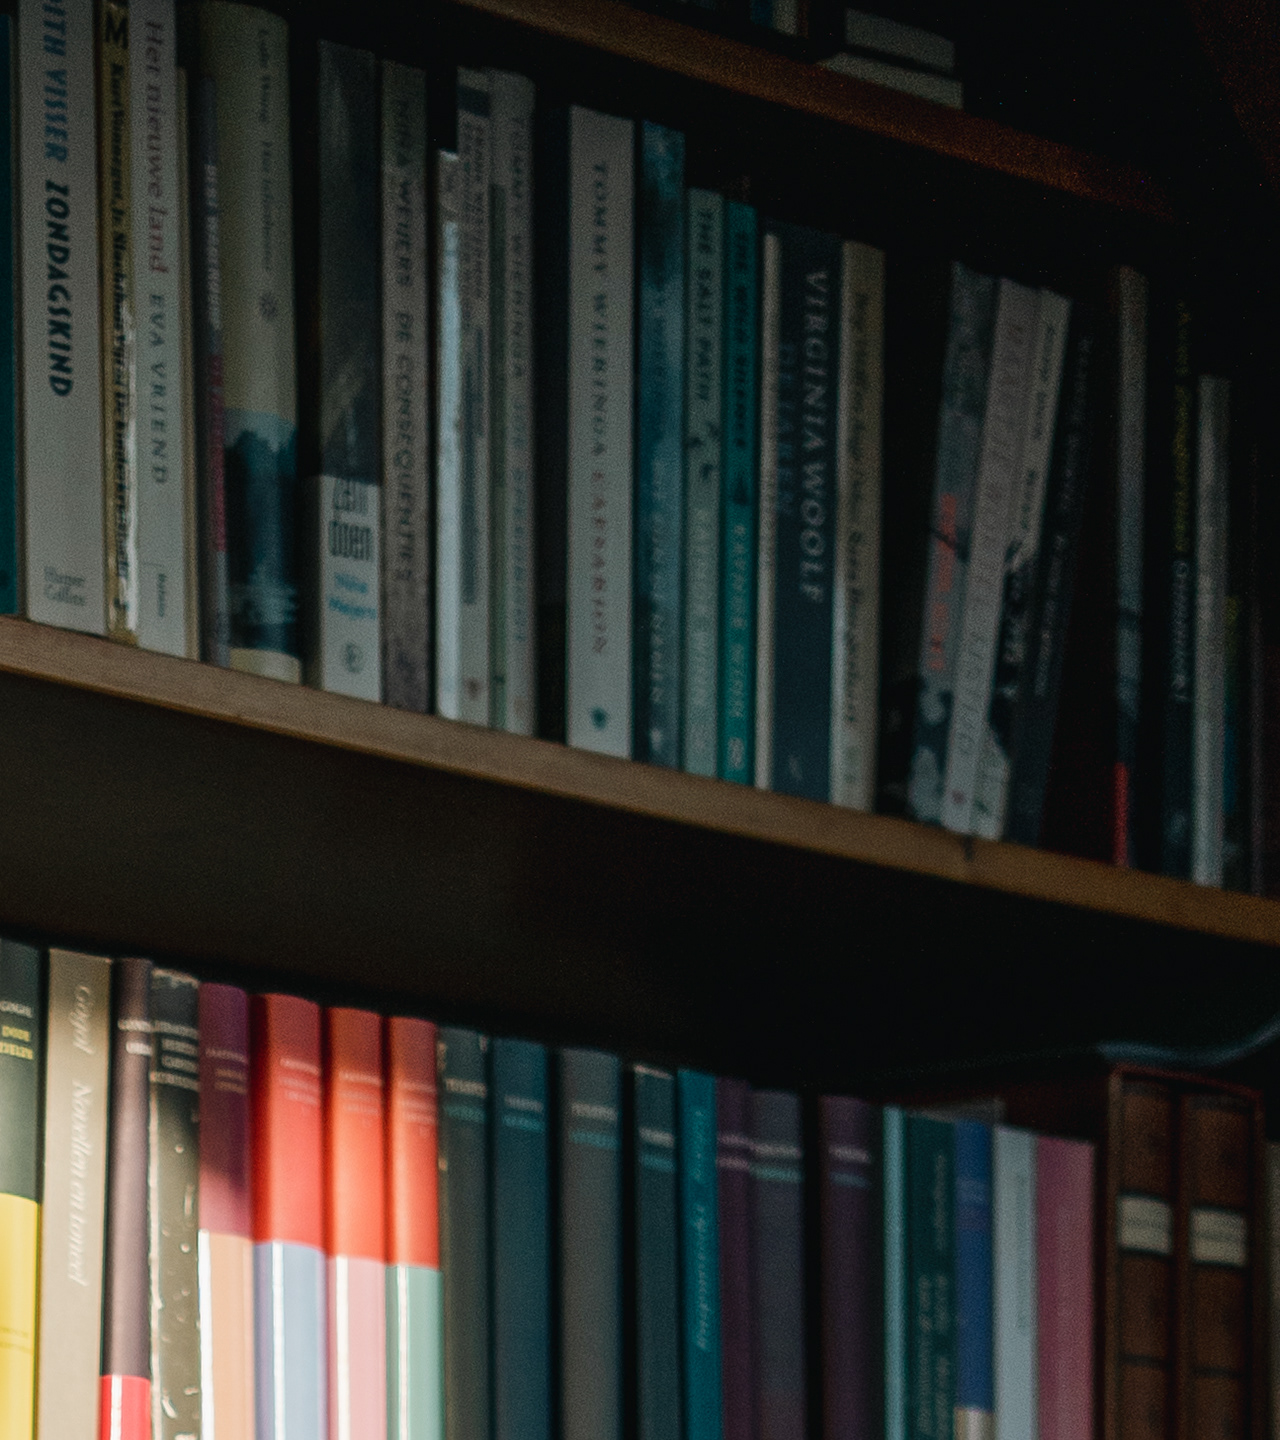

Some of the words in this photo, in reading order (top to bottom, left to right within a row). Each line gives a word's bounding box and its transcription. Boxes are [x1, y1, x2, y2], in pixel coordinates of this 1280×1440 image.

[44, 180, 75, 397] ZONDAGSKIND
[149, 292, 167, 350] EVA
[149, 357, 168, 486] VRIEND
[803, 268, 830, 453] VIRGINIA
[799, 462, 826, 602] WOOLF
